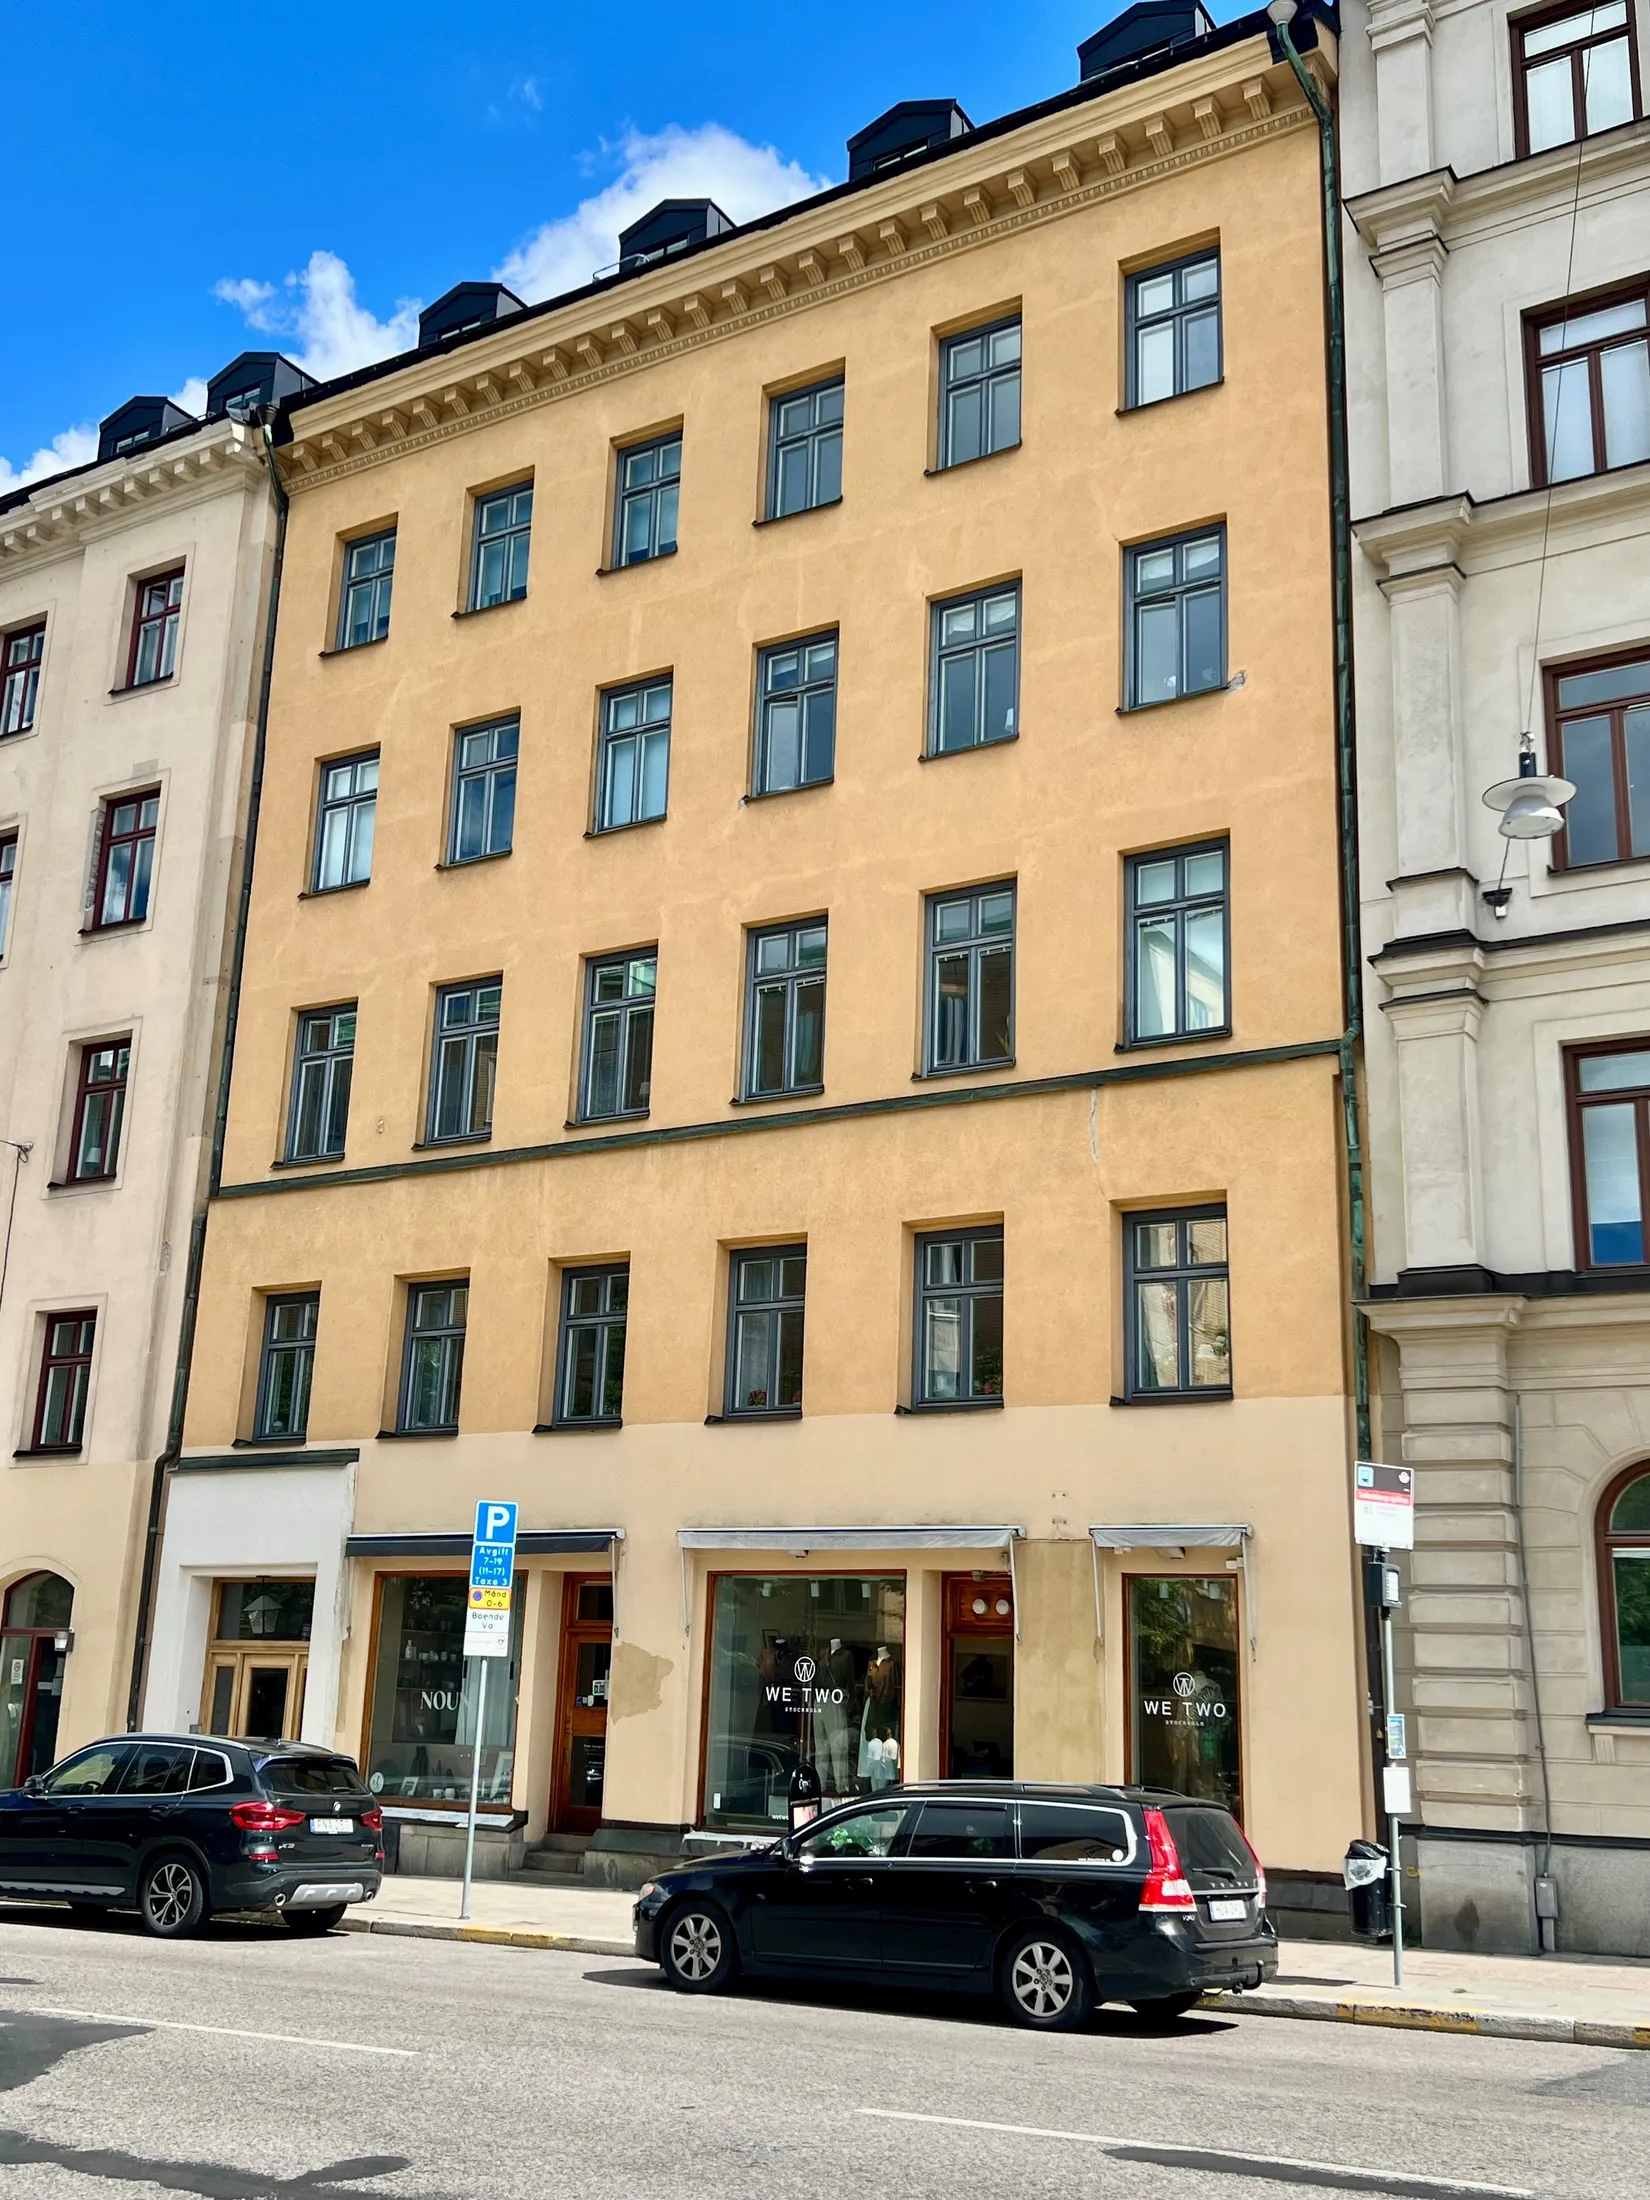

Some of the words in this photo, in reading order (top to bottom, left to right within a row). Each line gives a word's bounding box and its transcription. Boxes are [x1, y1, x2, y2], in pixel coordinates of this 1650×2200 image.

[485, 1505, 510, 1540] P
[478, 1546, 509, 1557] Avgift
[483, 1557, 503, 1566] 7-19
[478, 1566, 505, 1577] (11-17)
[475, 1576, 497, 1586] Taxa
[501, 1577, 508, 1586] 3
[484, 1589, 507, 1598] Månd
[486, 1599, 503, 1608] 0-6
[471, 1611, 505, 1621] Boende
[765, 1686, 792, 1702] WE
[801, 1687, 844, 1704] TWO
[784, 1706, 822, 1714] STOCKHOLM
[1143, 1700, 1172, 1716] WE
[1182, 1701, 1226, 1718] TWO
